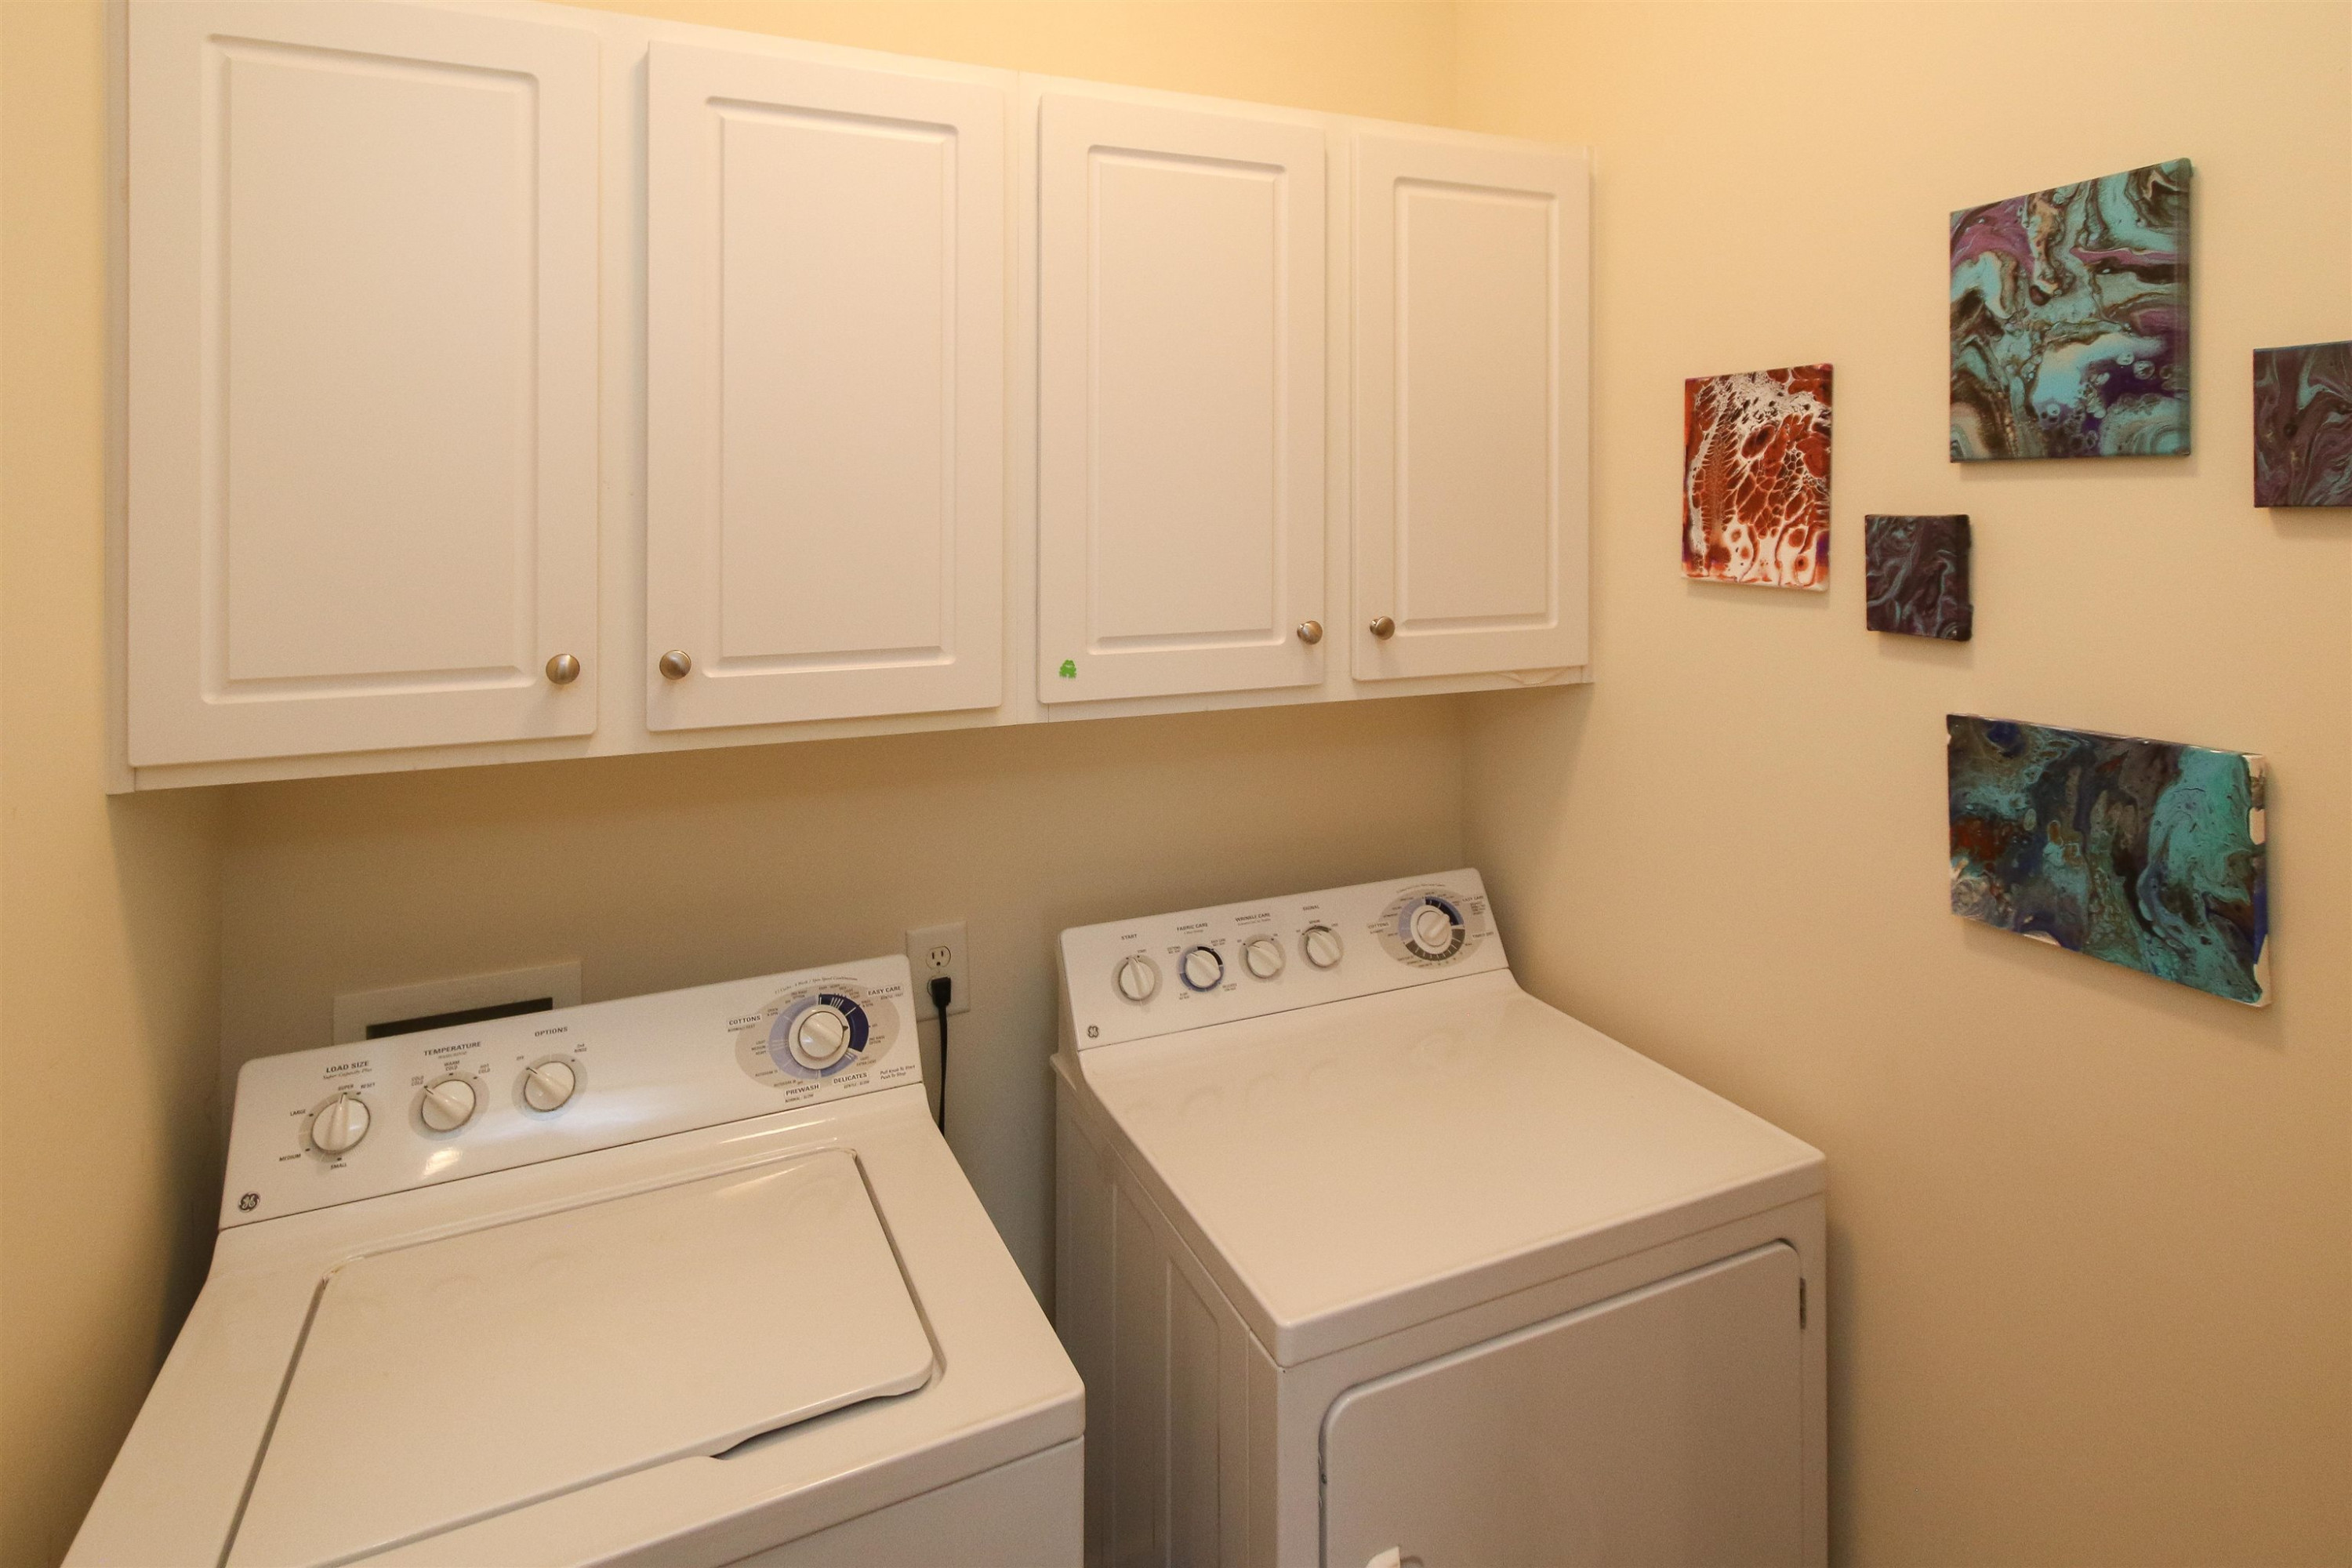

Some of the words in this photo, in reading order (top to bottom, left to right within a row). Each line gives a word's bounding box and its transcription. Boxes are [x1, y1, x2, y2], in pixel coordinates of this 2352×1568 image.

[1235, 914, 1258, 923] WRINKLE
[729, 1014, 760, 1025] COTTONS
[535, 1026, 568, 1037] OPTIONS
[423, 1040, 481, 1056] TEMPERATURE
[326, 1064, 350, 1073] LOAD
[351, 1060, 369, 1069] SIZE
[833, 1072, 867, 1084] DELICATES
[786, 1083, 819, 1096] PREWASH
[279, 1152, 302, 1162] MEDIUM
